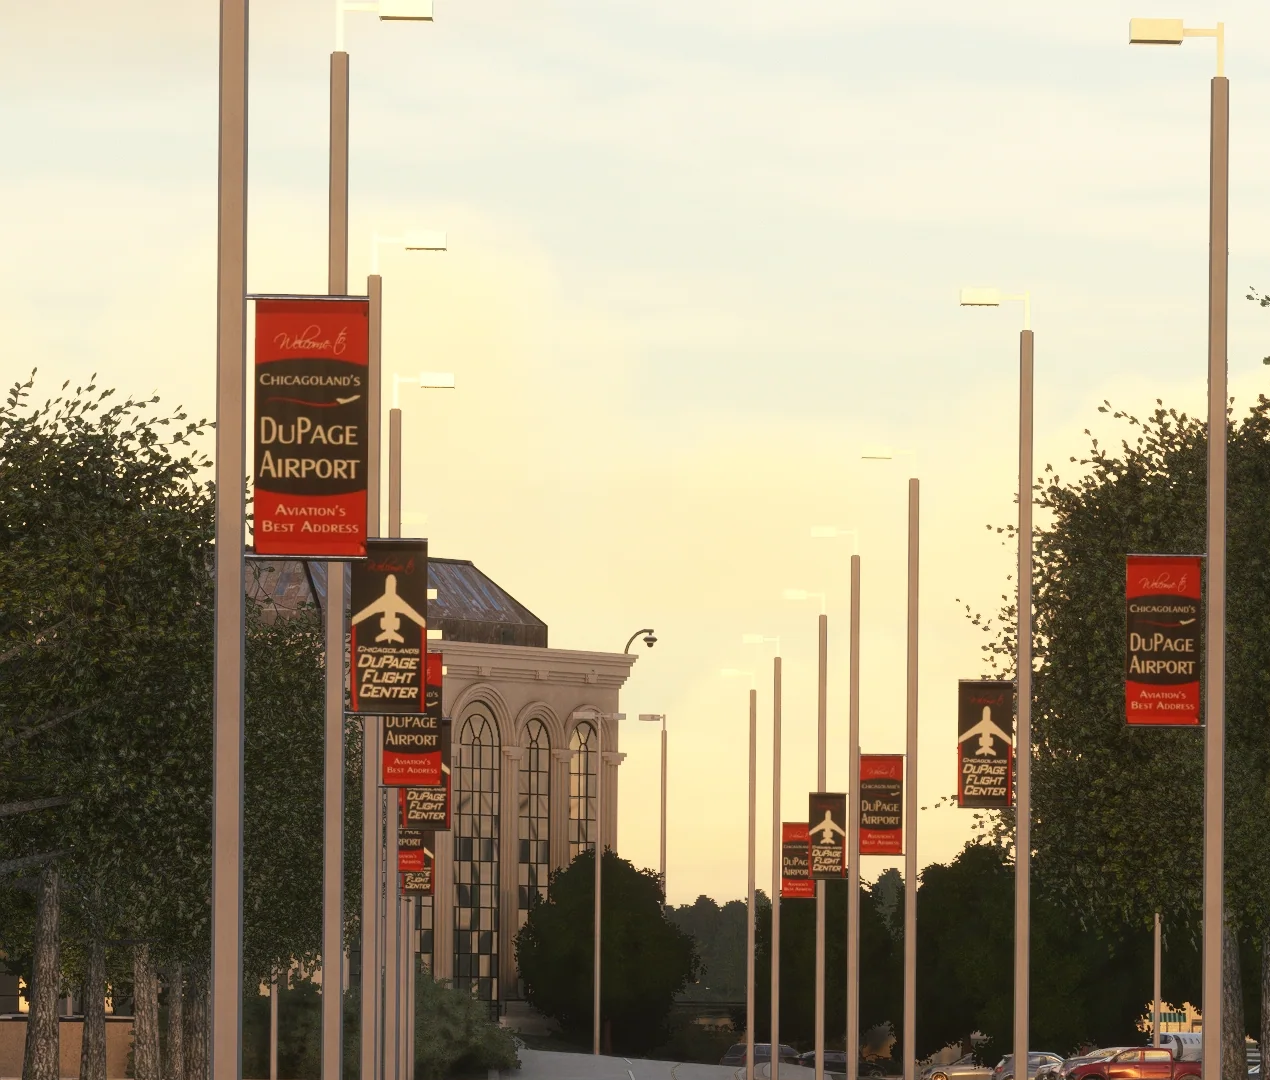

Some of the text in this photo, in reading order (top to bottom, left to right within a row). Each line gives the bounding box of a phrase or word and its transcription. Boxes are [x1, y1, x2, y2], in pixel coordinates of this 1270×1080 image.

[273, 324, 347, 355] Welcome to
[260, 373, 361, 386] CHICAGOLAND'S
[259, 450, 360, 479] AIRPORT
[275, 504, 346, 516] AVIATION'S
[262, 520, 359, 533] BEST ADDRESS
[1130, 604, 1196, 613] CHICAGOLAND'S
[1129, 655, 1196, 675] AIRPORT
[362, 669, 416, 684] FLIGHT
[359, 683, 418, 698] CENTER
[1140, 690, 1186, 700] AVIATION'S
[1131, 701, 1195, 711] BEST ADDRESS
[385, 730, 439, 746] AIRPORT
[966, 774, 1004, 786] FLIGHT
[964, 785, 1006, 797] CENTER
[409, 801, 444, 811] FLIGHT
[407, 810, 446, 820] CENTER
[861, 813, 900, 825] AIRPORT
